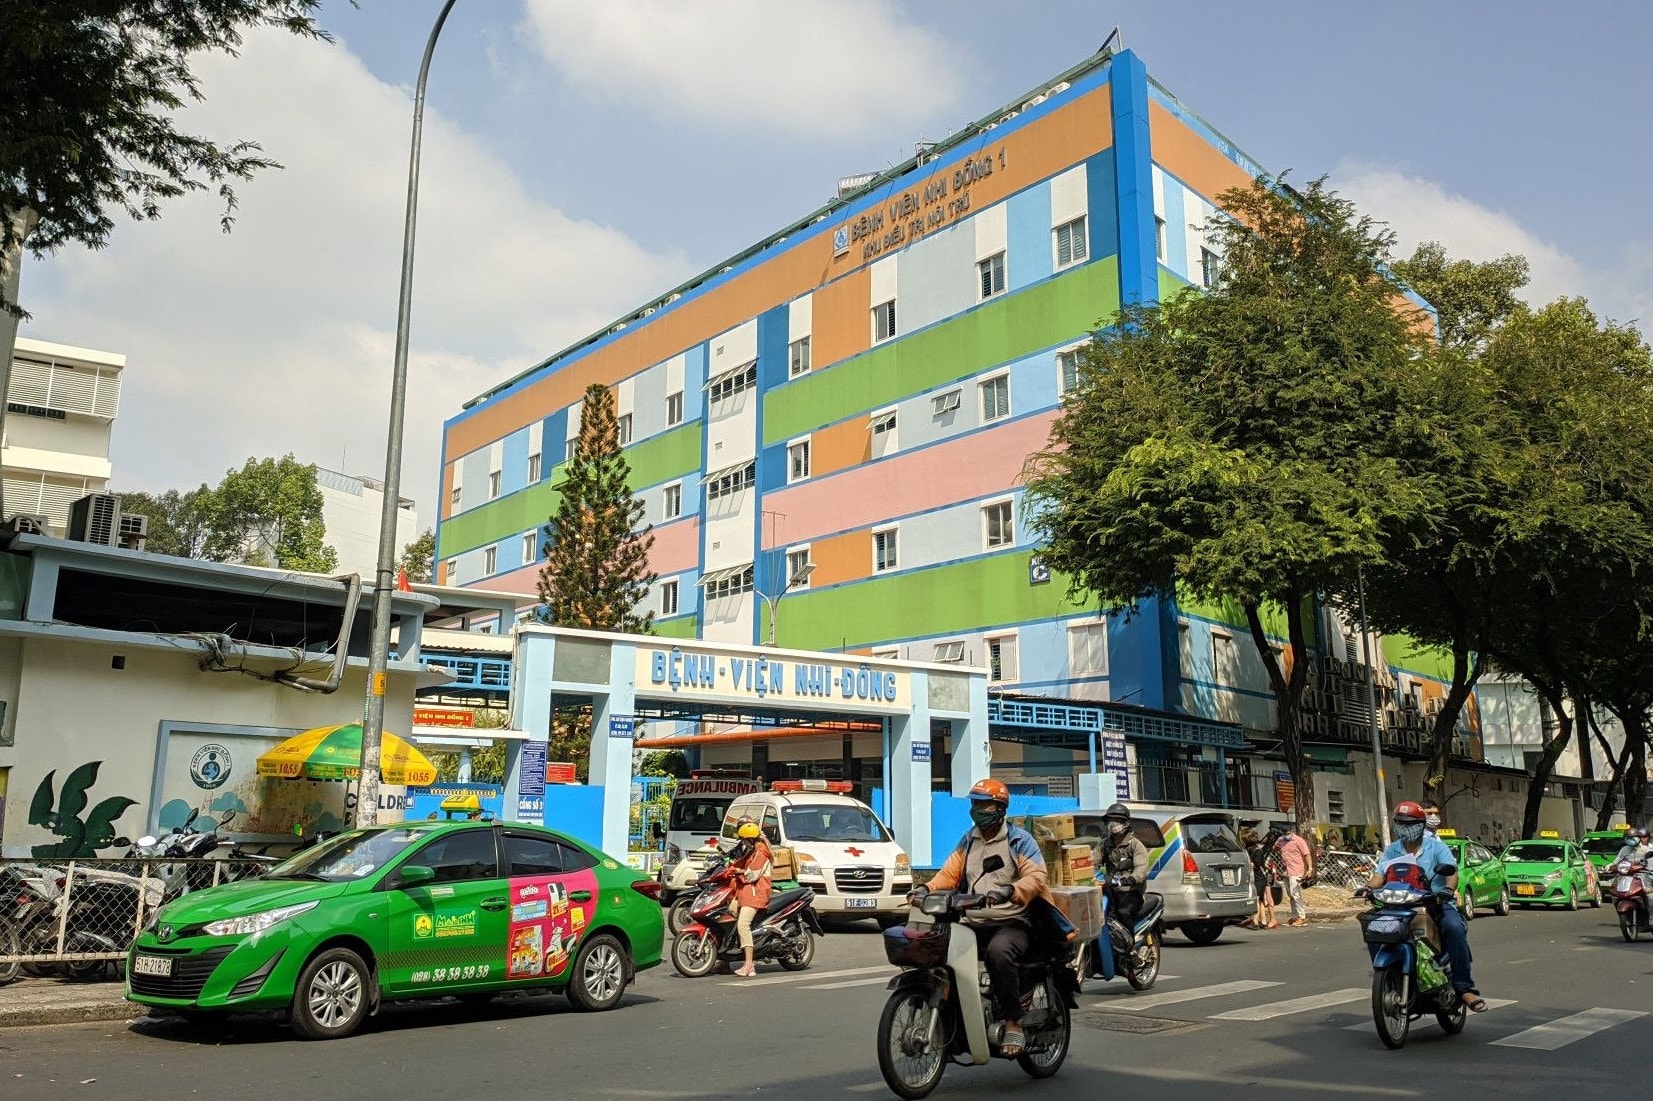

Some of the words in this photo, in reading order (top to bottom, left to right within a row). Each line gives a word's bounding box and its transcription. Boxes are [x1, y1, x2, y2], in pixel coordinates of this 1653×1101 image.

[852, 210, 884, 243] BỆNH
[890, 191, 920, 223] VIỆN
[924, 177, 947, 206] NHI
[998, 147, 1007, 170] 1
[652, 646, 715, 691] BỆNH
[841, 663, 896, 702] ĐỒNG
[279, 763, 298, 775] 1055
[343, 767, 361, 778] 105
[408, 772, 430, 783] 1055
[412, 971, 431, 983] (028)
[432, 968, 446, 982] 38
[447, 967, 461, 980] 38
[462, 966, 476, 980] 38
[476, 965, 490, 978] 38
